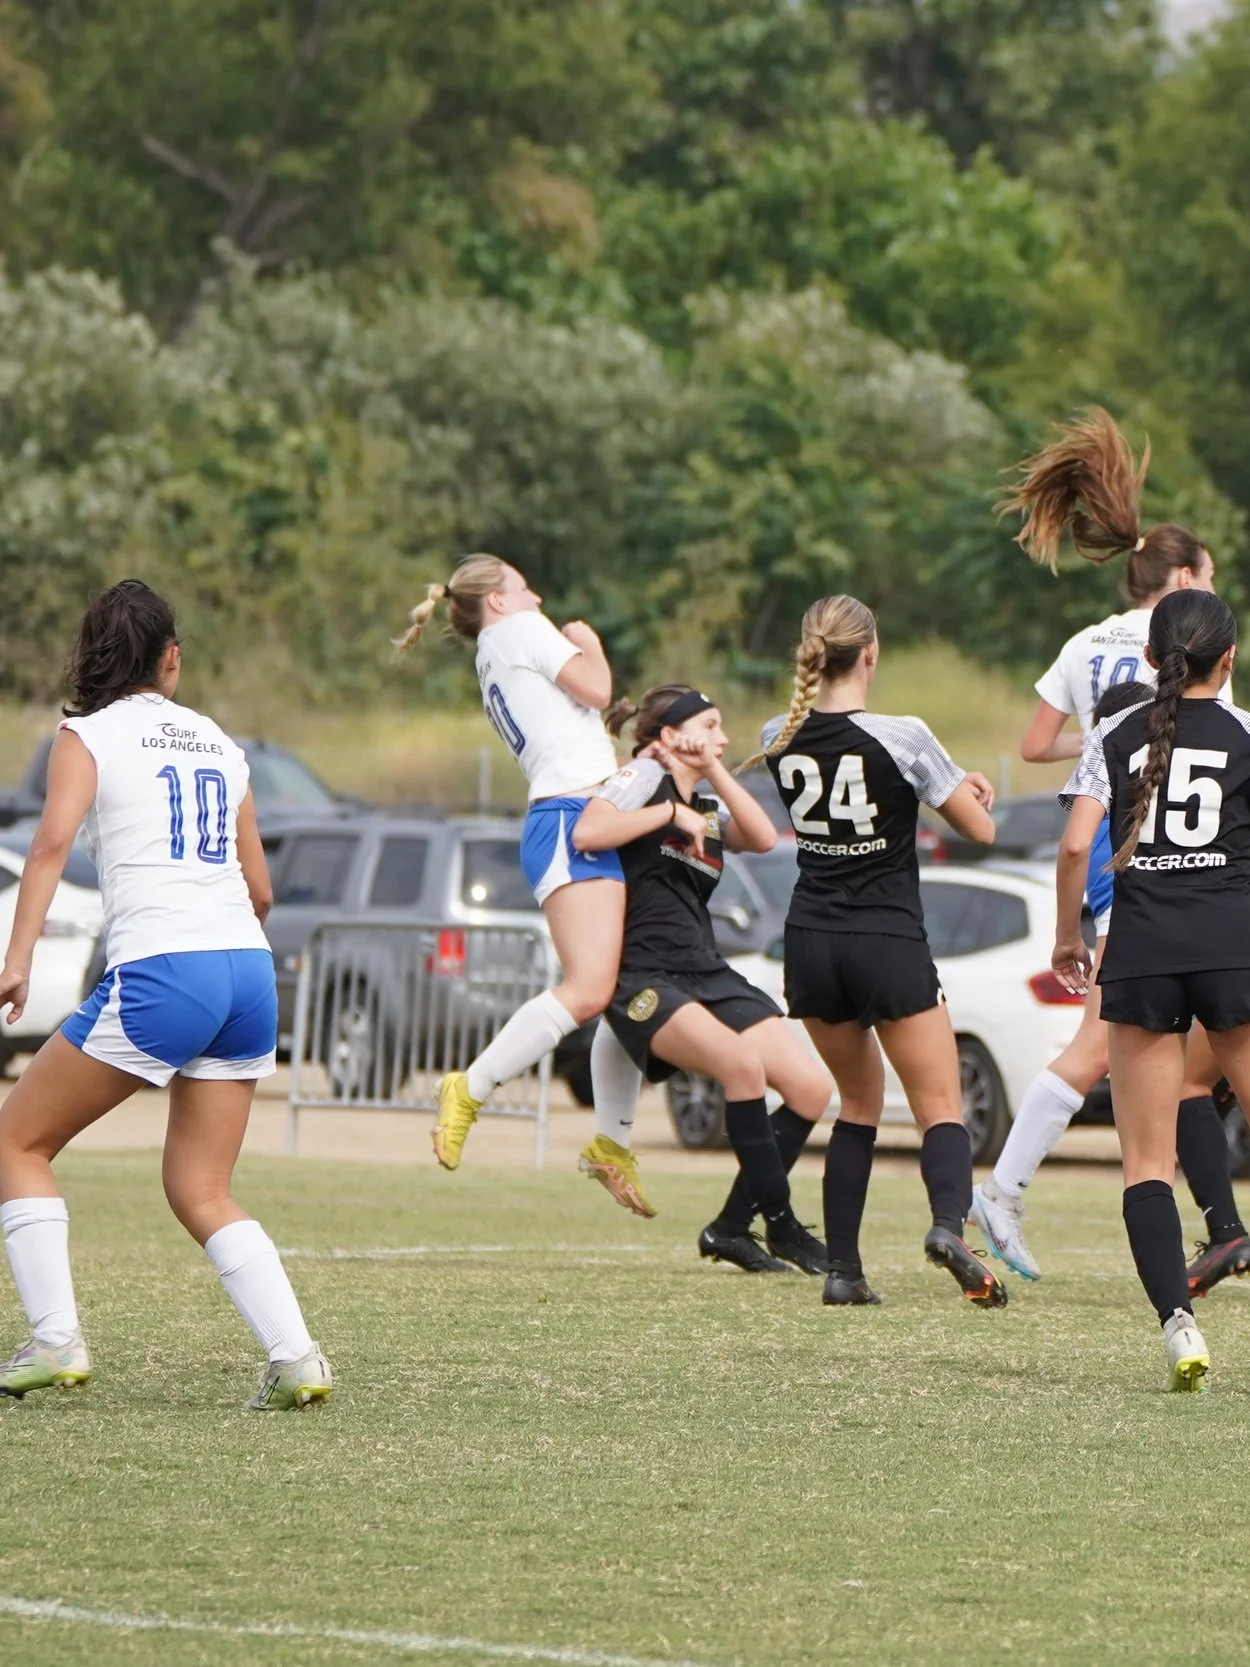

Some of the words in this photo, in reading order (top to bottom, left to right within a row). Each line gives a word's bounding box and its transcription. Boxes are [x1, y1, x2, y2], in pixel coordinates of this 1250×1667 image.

[1090, 635, 1117, 645] SANTA
[141, 737, 167, 749] LOS
[168, 739, 224, 756] ANGELES
[163, 726, 198, 740] SURF
[155, 764, 229, 865] 10
[778, 754, 878, 836] 24
[1128, 743, 1228, 848] 15
